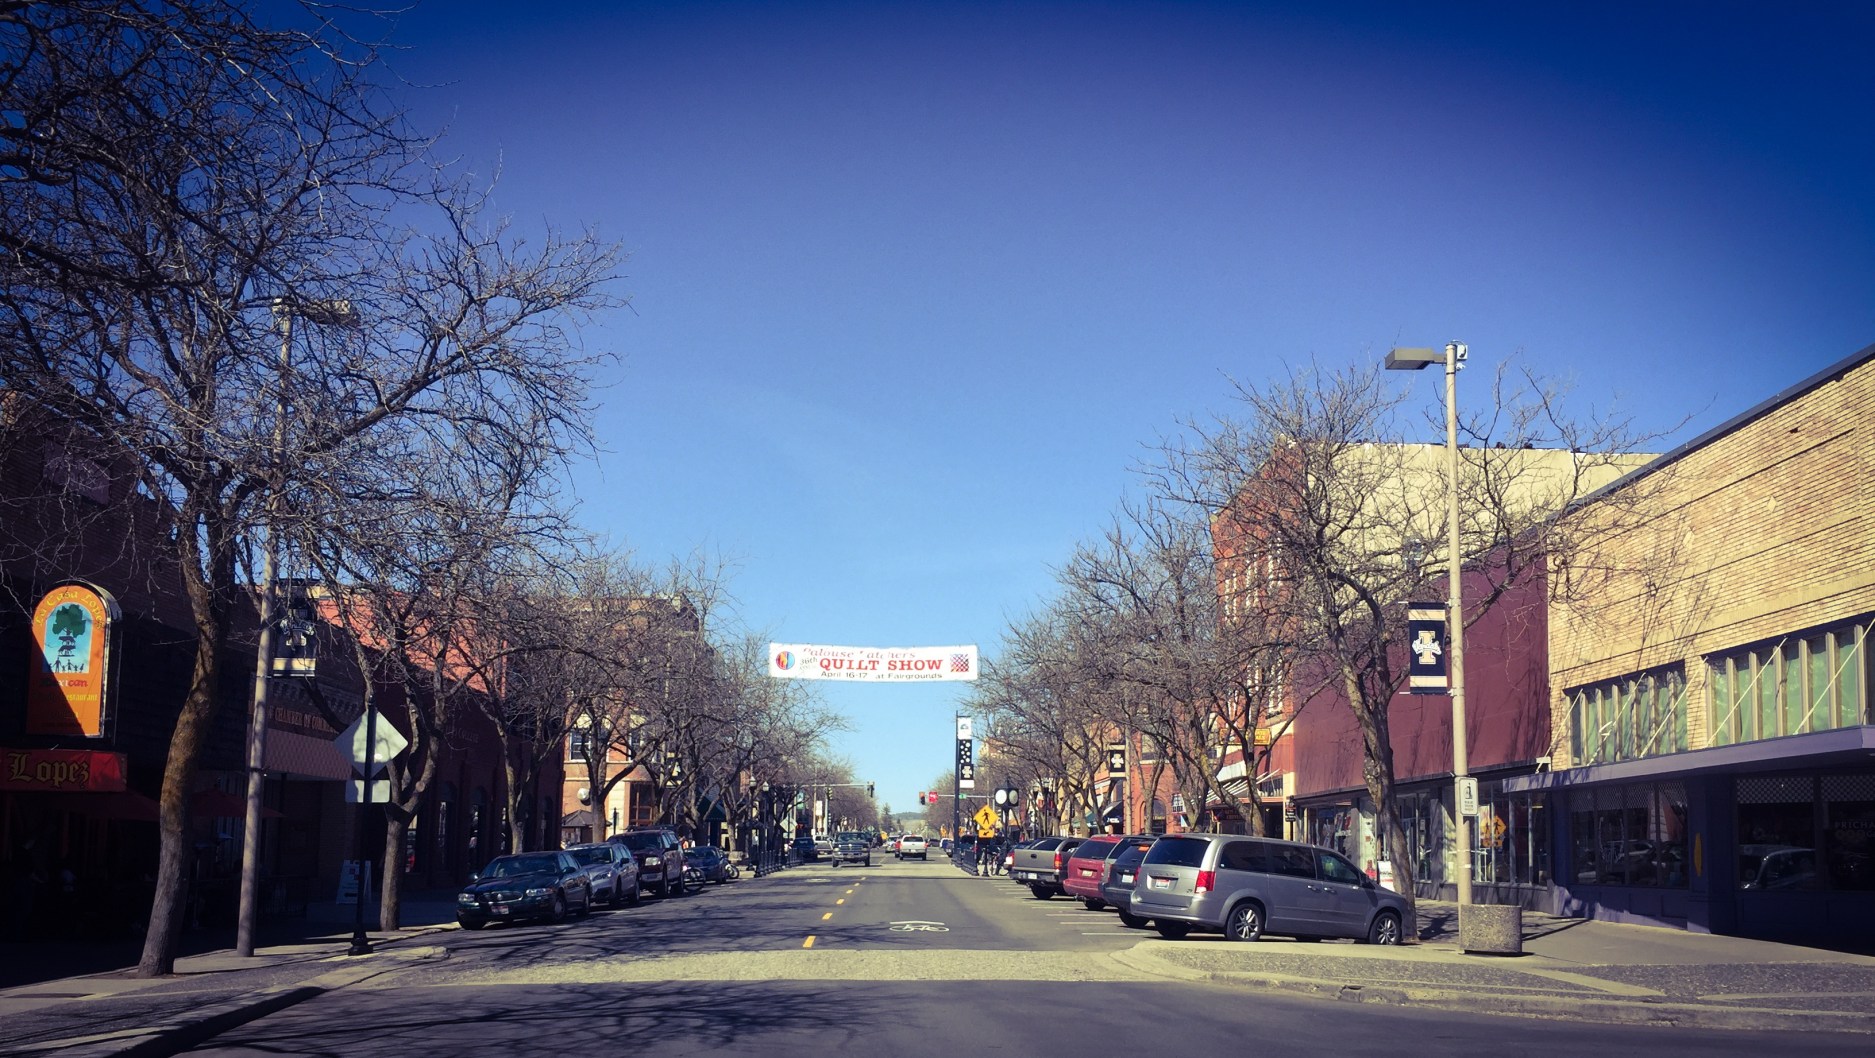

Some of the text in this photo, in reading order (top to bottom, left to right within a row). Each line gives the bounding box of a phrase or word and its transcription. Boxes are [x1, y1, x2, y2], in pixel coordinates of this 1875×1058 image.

[46, 591, 79, 606] Casa
[800, 656, 818, 666] 36th
[819, 658, 880, 671] QUILT
[887, 659, 944, 671] SHOW
[820, 671, 842, 679] April
[887, 672, 943, 680] Fairgrounds
[8, 752, 90, 789] Lopez
